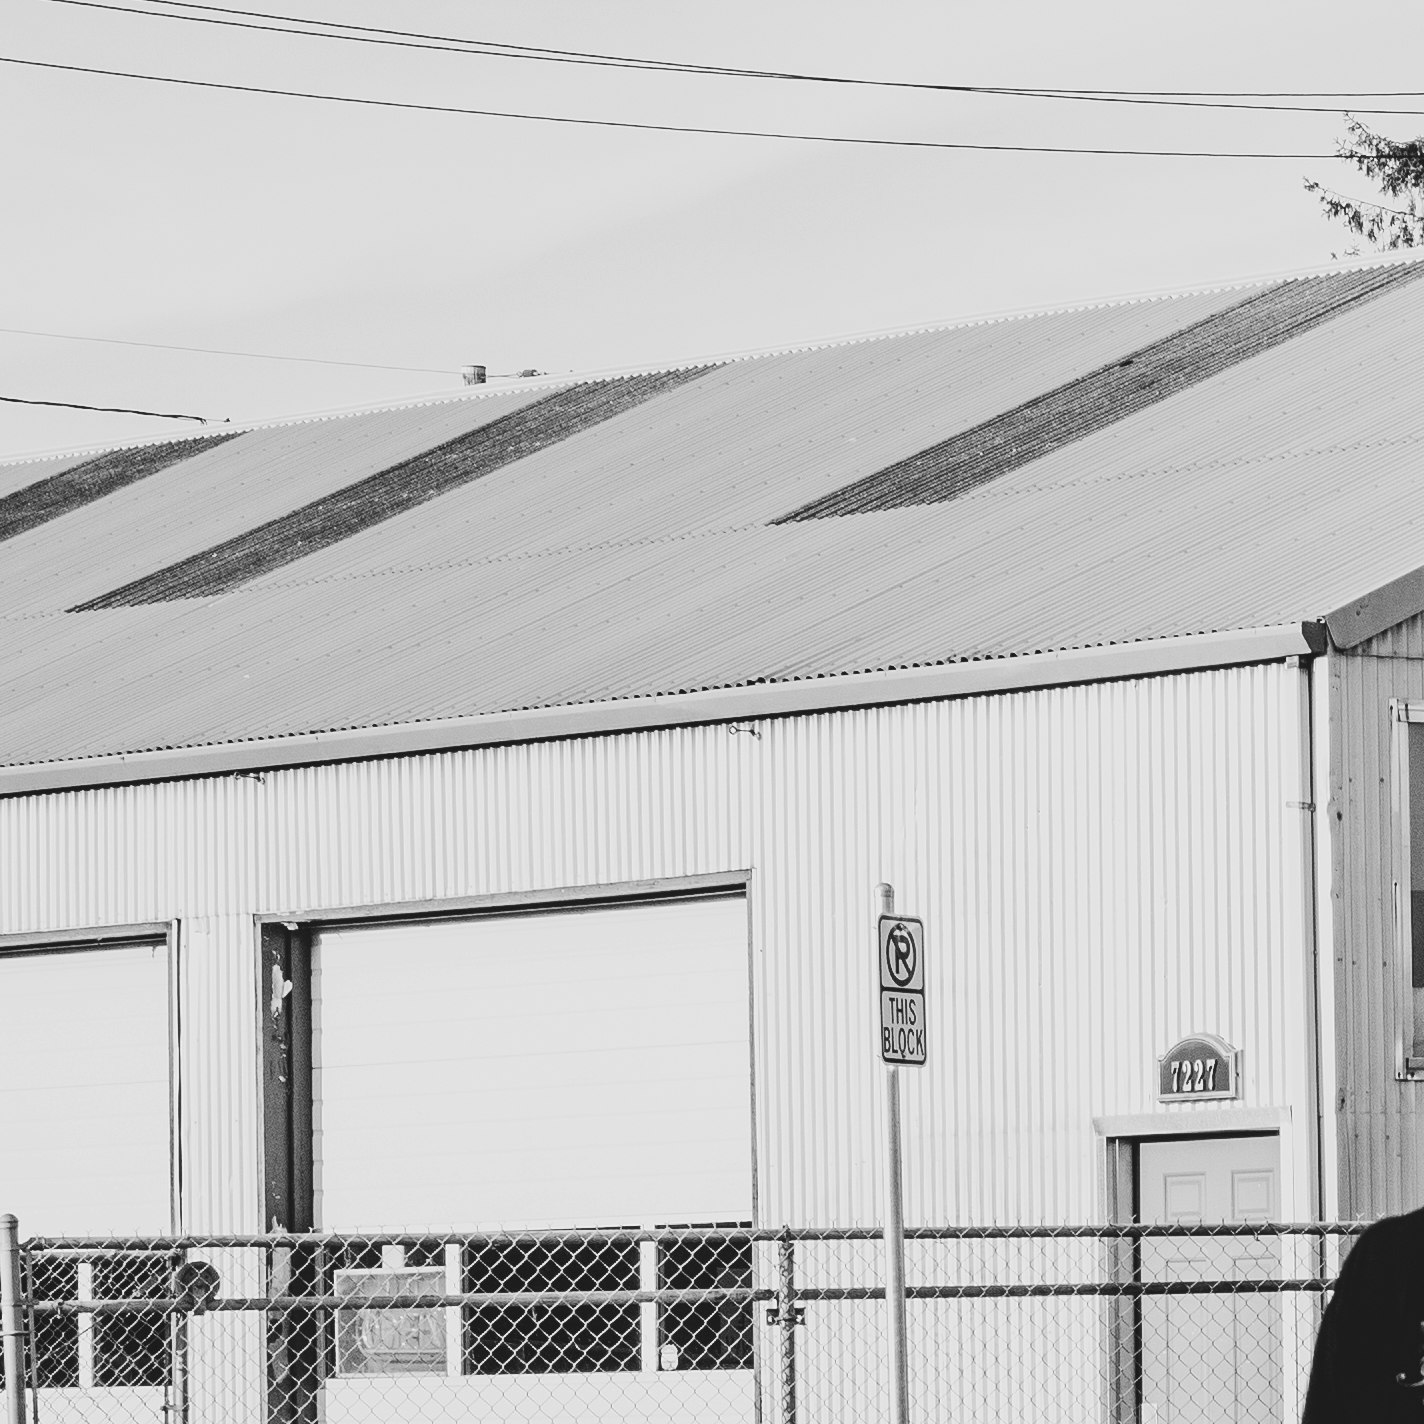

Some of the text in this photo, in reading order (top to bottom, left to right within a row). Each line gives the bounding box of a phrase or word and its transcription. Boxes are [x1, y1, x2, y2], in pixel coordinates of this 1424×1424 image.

[888, 997, 917, 1026] THIS
[883, 1026, 925, 1057] BLOCK
[1170, 1058, 1218, 1093] 7227
